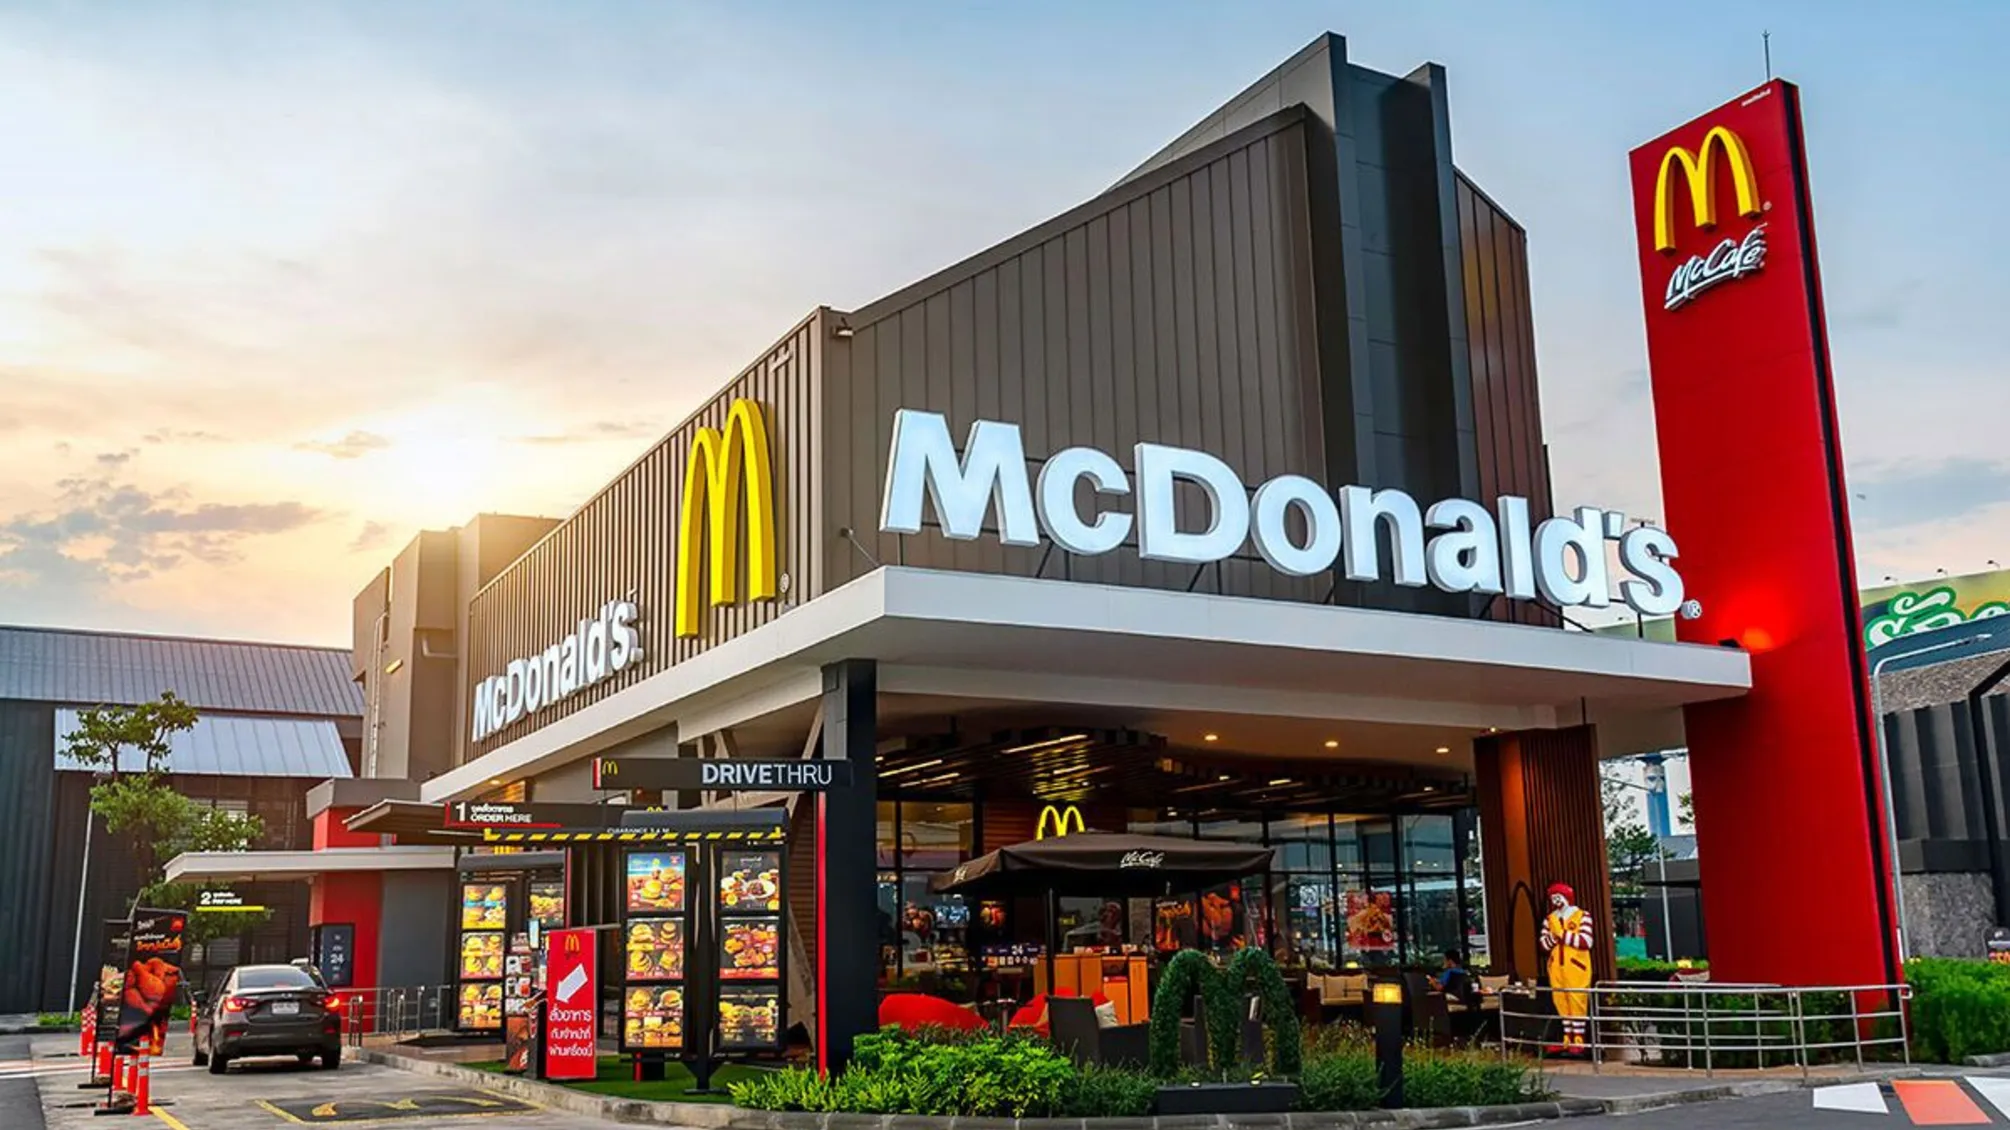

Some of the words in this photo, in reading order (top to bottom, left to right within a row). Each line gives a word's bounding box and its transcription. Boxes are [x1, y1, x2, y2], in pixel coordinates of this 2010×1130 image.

[455, 802, 466, 822] 1
[470, 813, 504, 823] ORDER
[505, 813, 533, 823] HERE
[201, 891, 211, 905] 2
